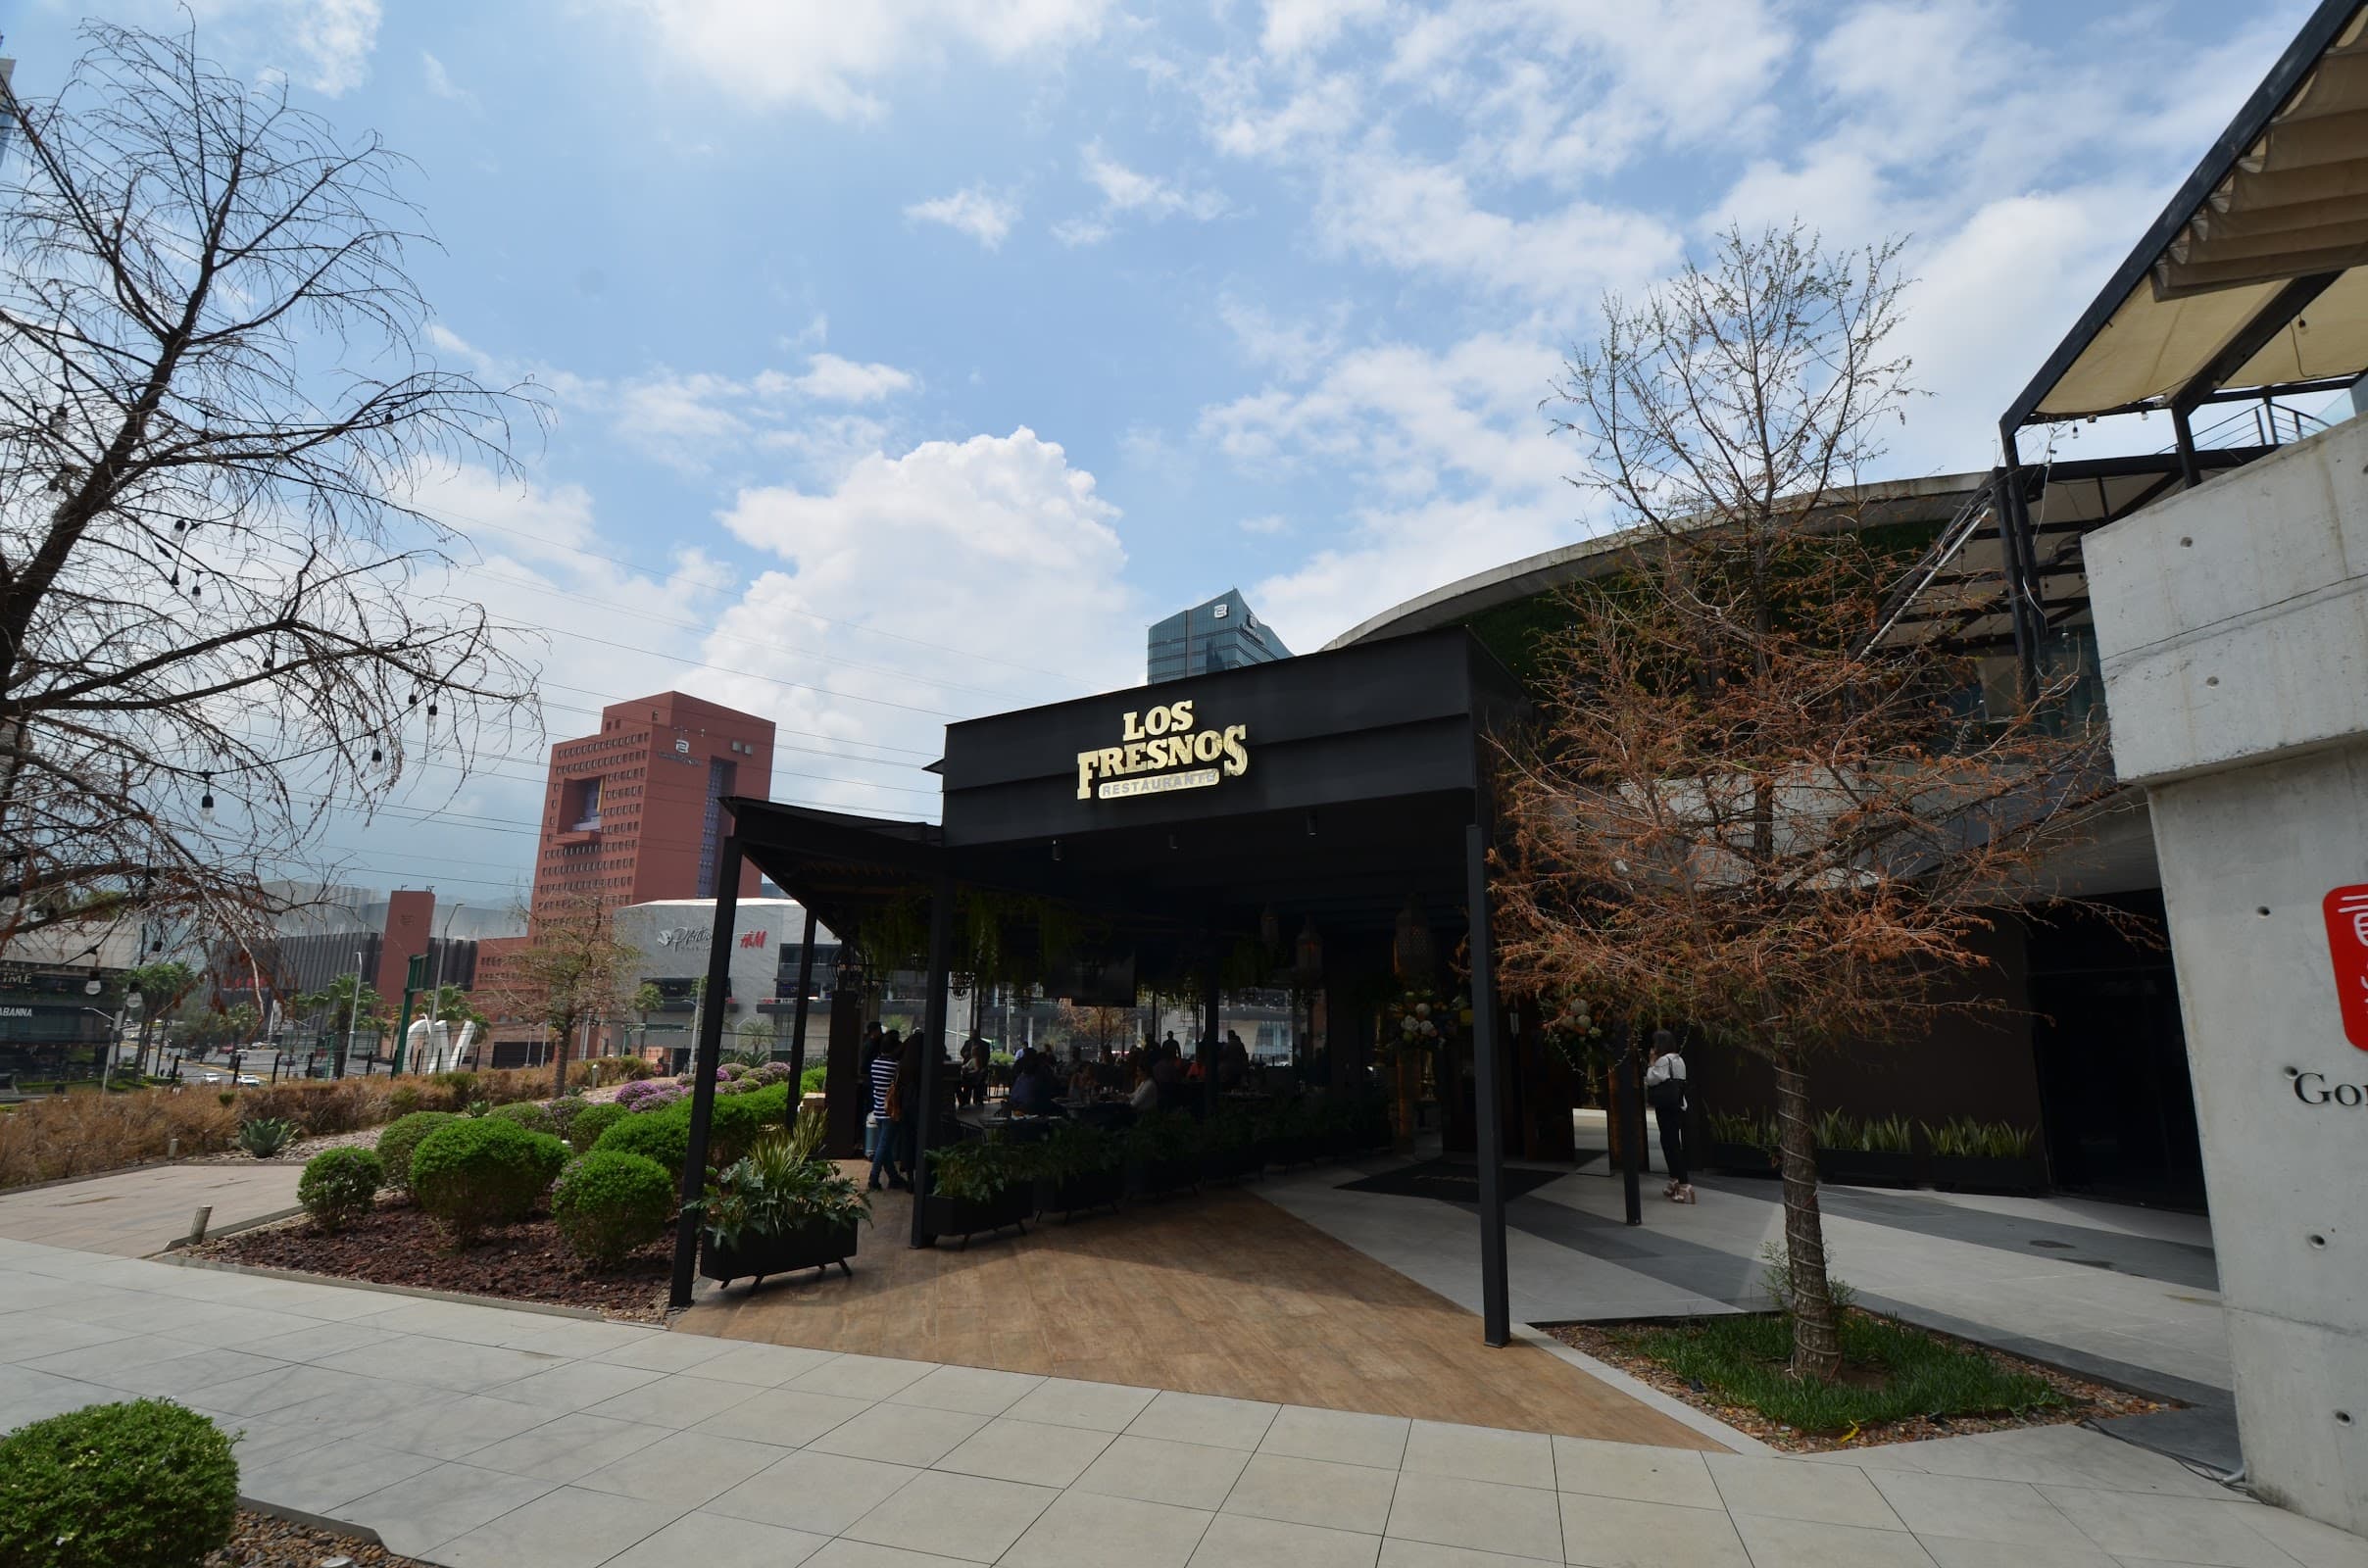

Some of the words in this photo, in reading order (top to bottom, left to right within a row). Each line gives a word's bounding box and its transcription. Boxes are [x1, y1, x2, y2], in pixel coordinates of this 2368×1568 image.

[1122, 700, 1194, 742] LOS
[1077, 724, 1248, 800] FRESNOS
[1102, 772, 1215, 797] RESTAURANTE
[2294, 1072, 2368, 1108] Go
